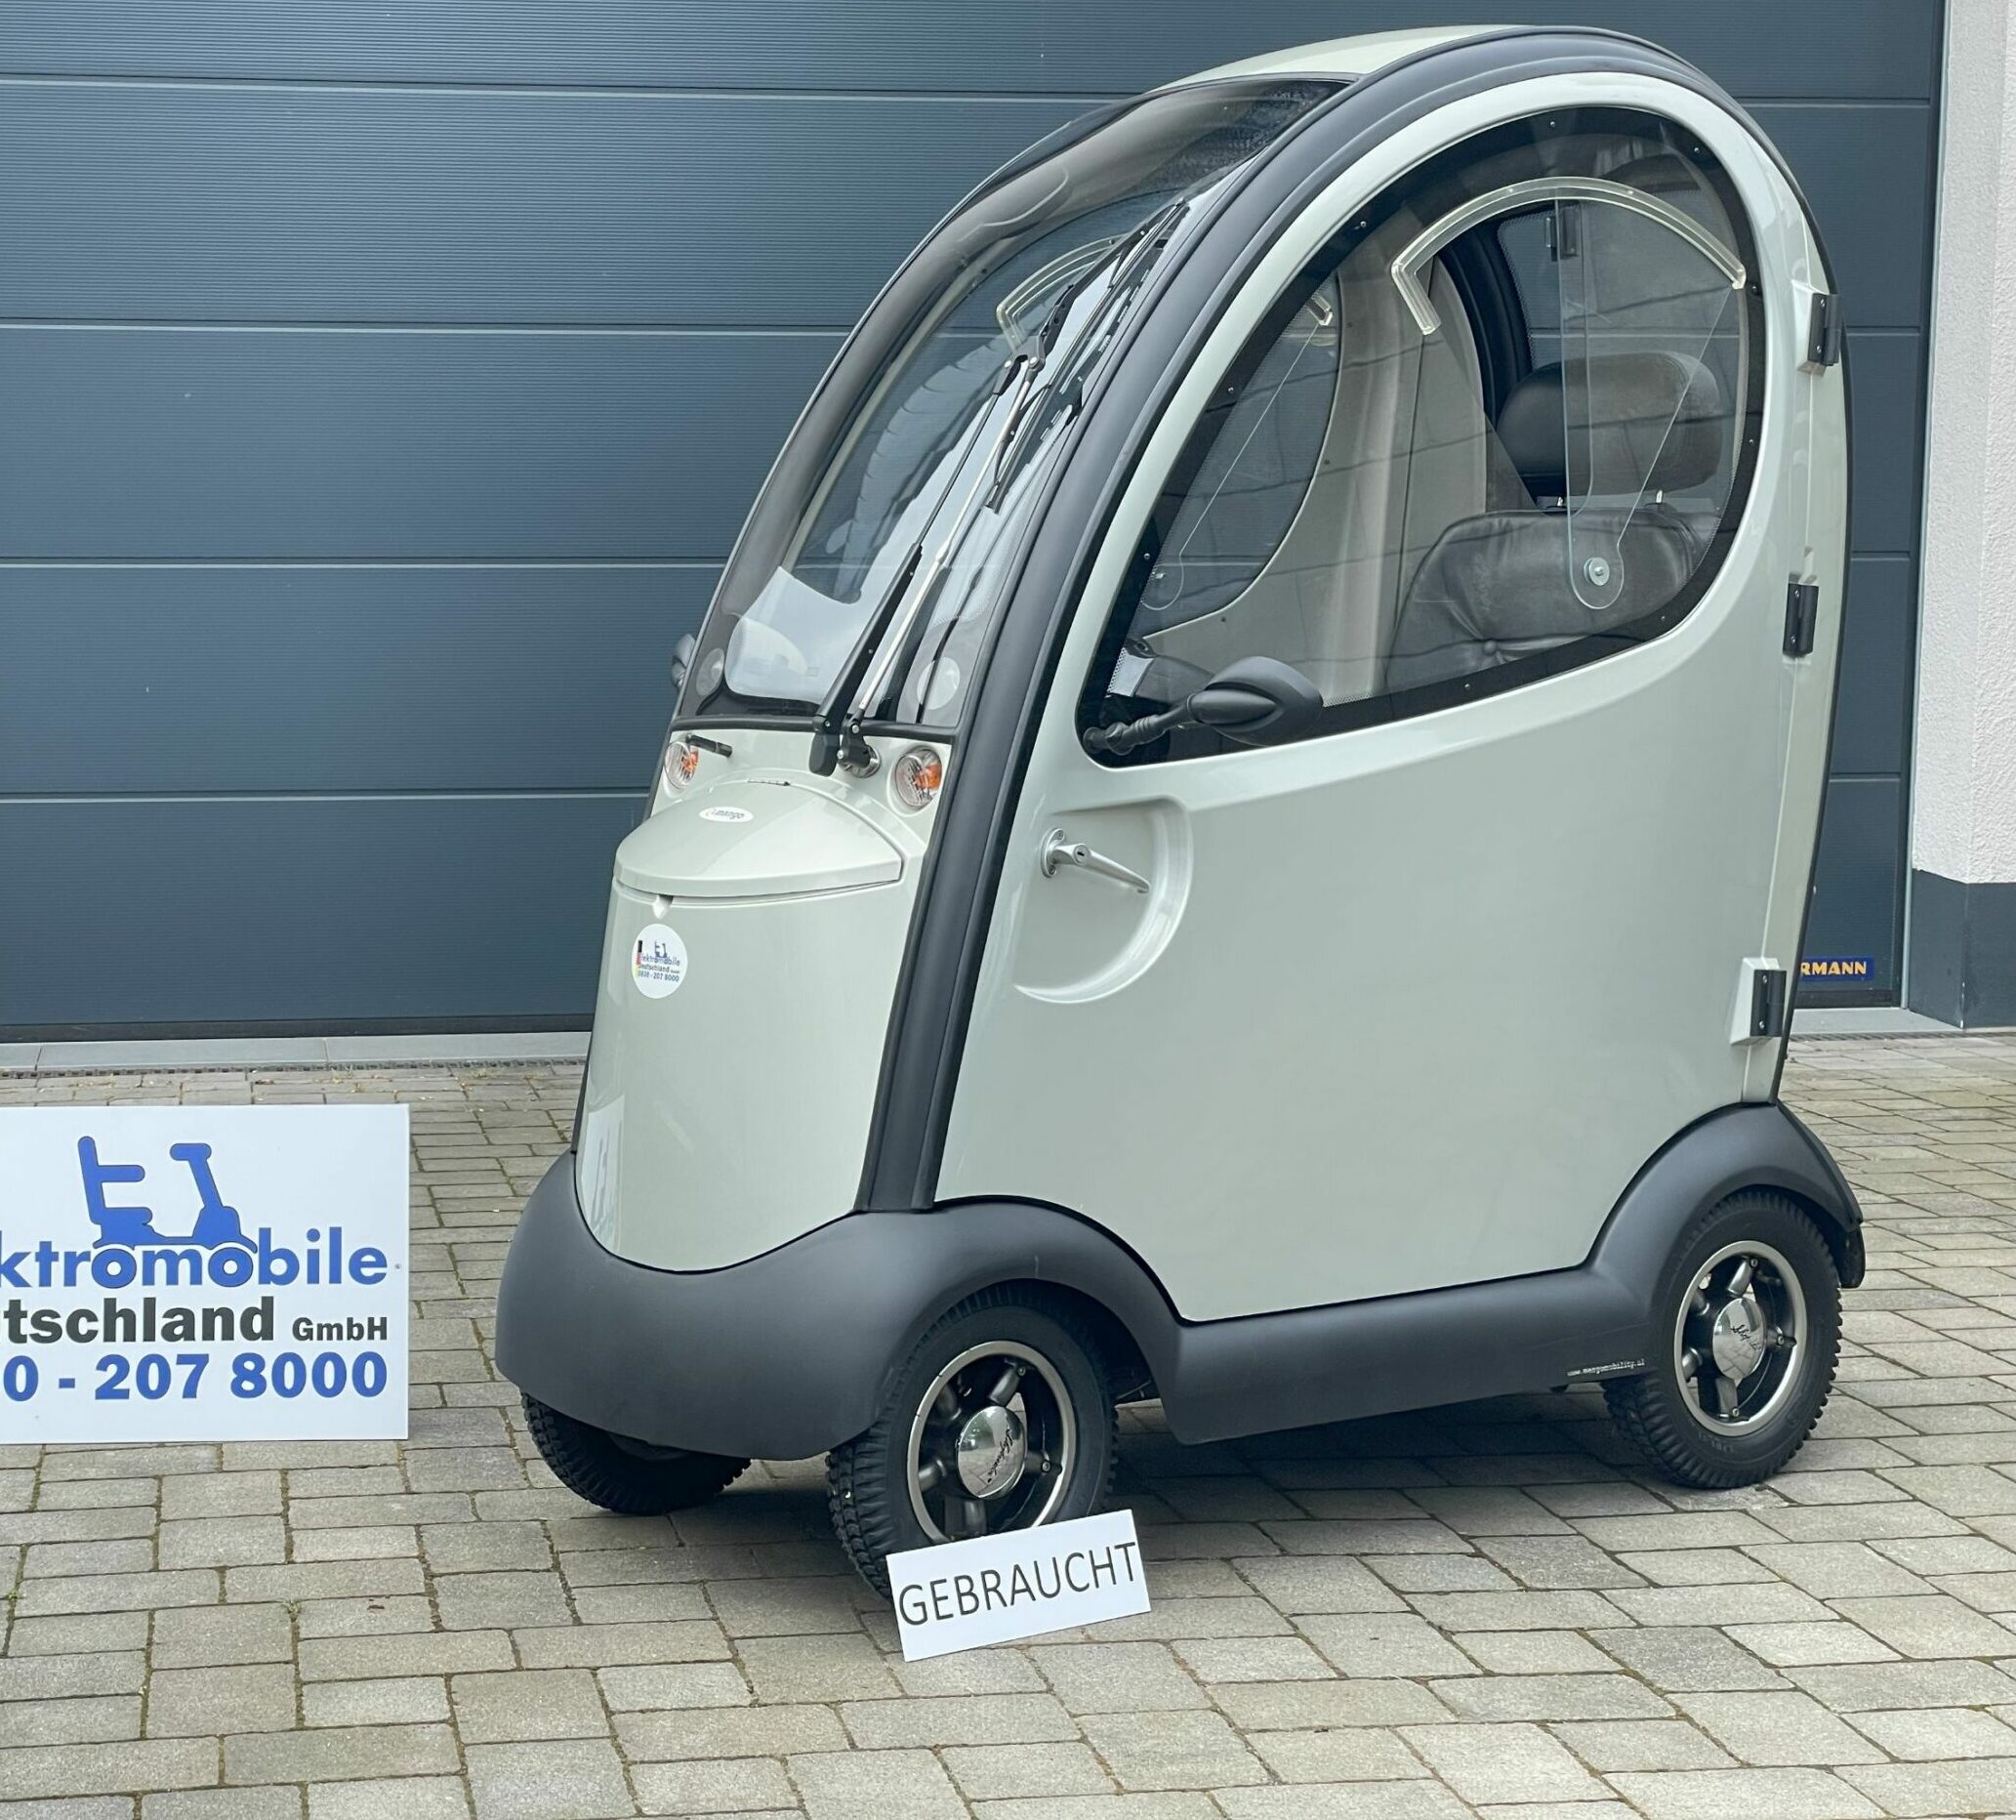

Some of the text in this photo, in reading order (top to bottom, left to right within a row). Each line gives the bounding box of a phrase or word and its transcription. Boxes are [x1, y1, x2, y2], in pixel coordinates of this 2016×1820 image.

[1800, 961, 1867, 975] RMANN
[3, 1296, 388, 1344] tschland GmbH
[3, 1351, 388, 1402] 0 - 207 8000
[898, 1542, 1136, 1626] GEBRAUCHT
